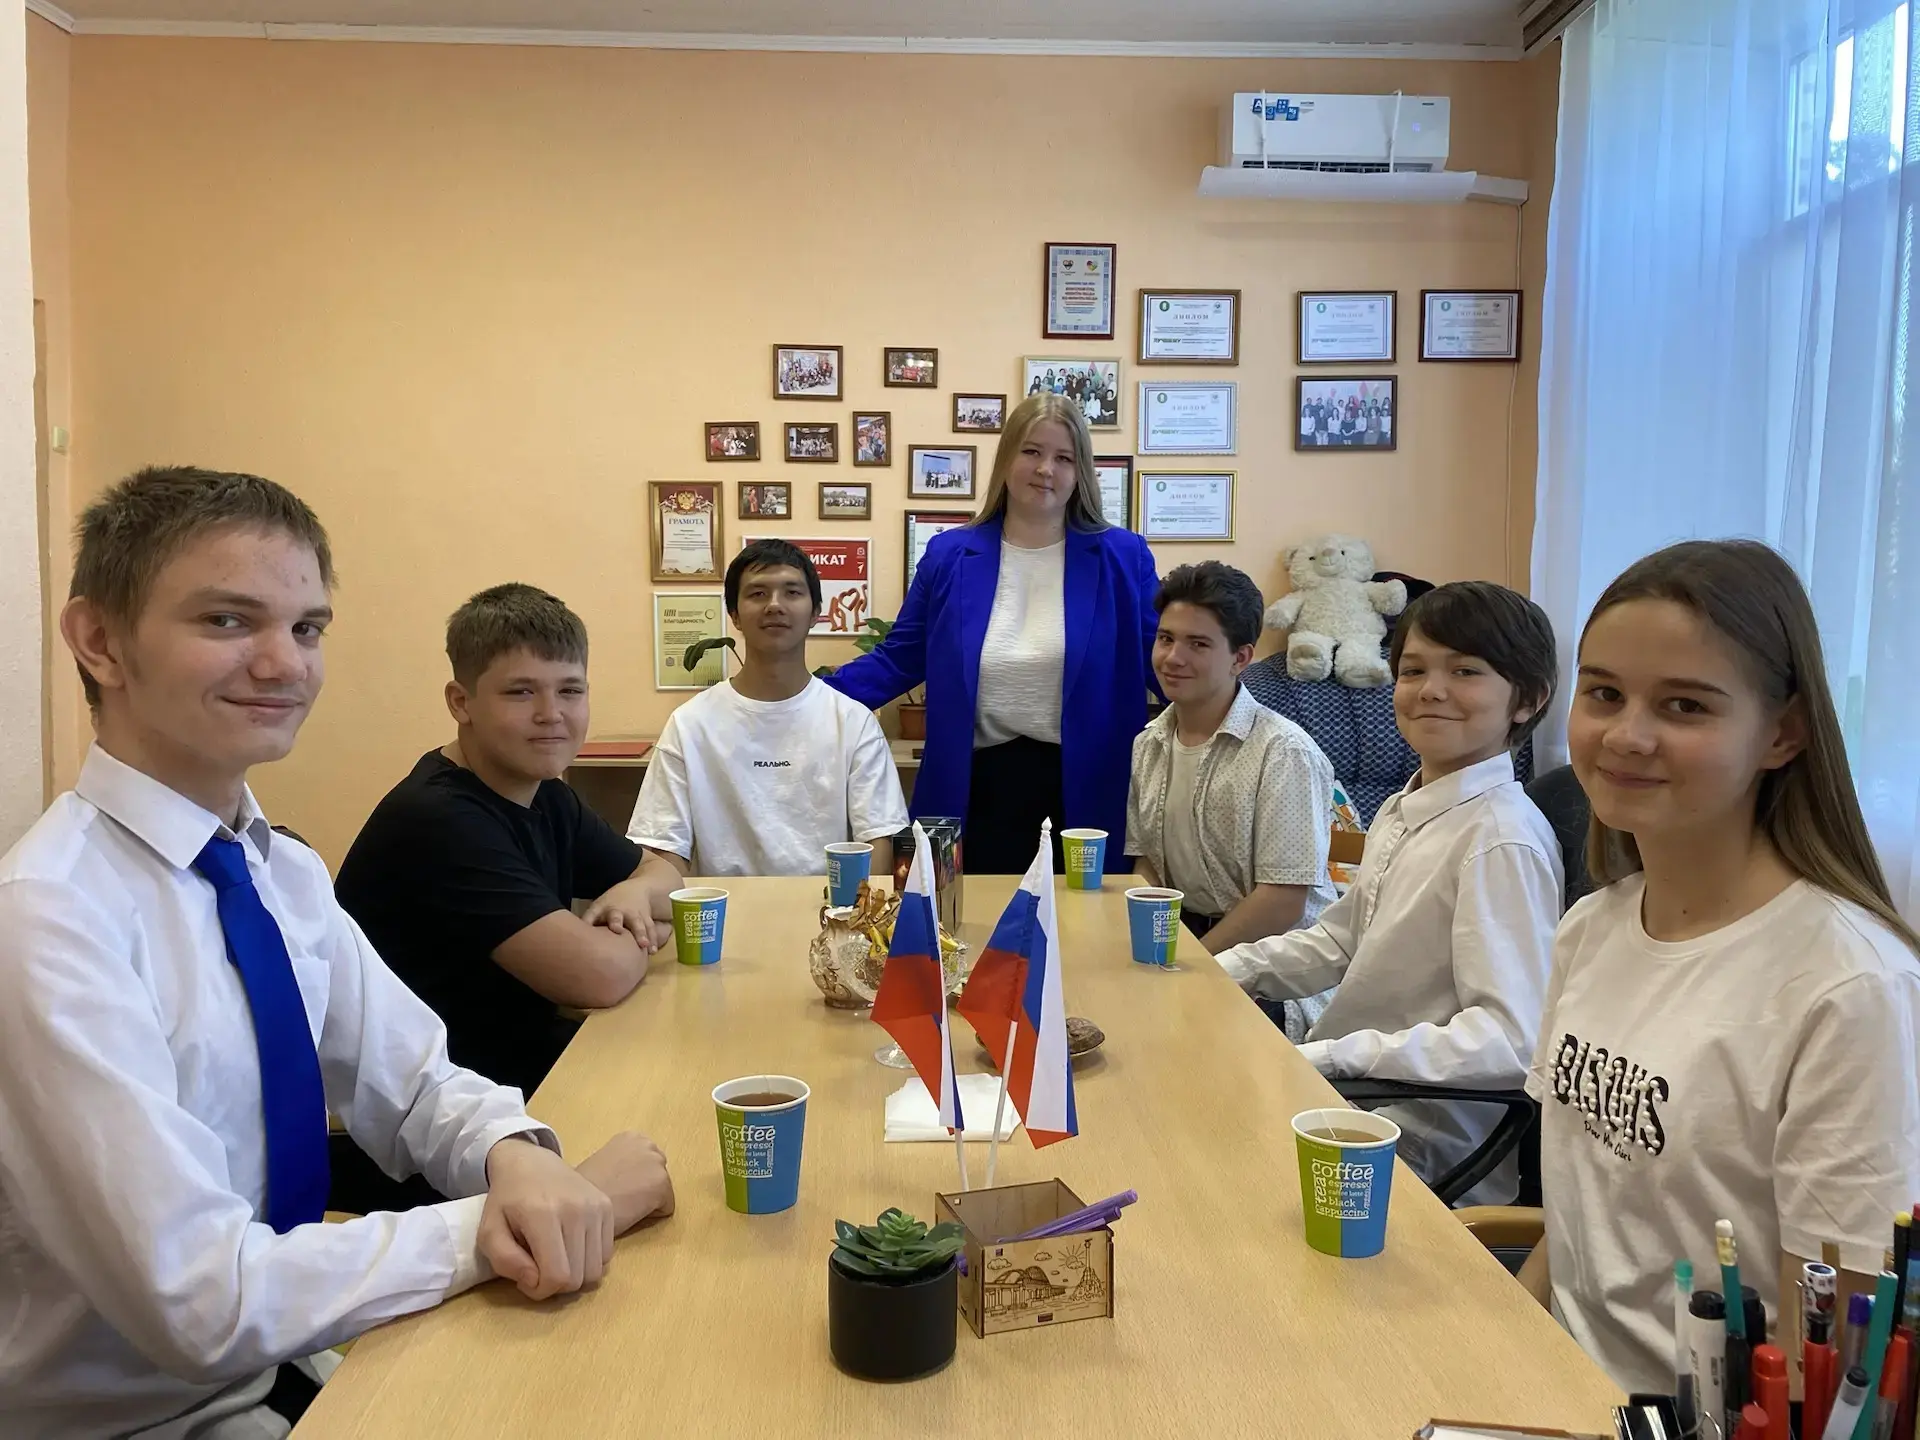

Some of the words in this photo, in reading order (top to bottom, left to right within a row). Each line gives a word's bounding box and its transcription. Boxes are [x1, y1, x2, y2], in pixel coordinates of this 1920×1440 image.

[683, 910, 719, 921] coffee
[722, 1125, 776, 1142] coffee
[734, 1141, 774, 1153] espresso
[735, 1157, 760, 1168] black
[728, 1164, 773, 1176] cappuccino
[1311, 1161, 1375, 1181] coffee
[1328, 1179, 1373, 1191] espresso
[1328, 1196, 1357, 1208] black
[1315, 1203, 1370, 1218] cappuccino
